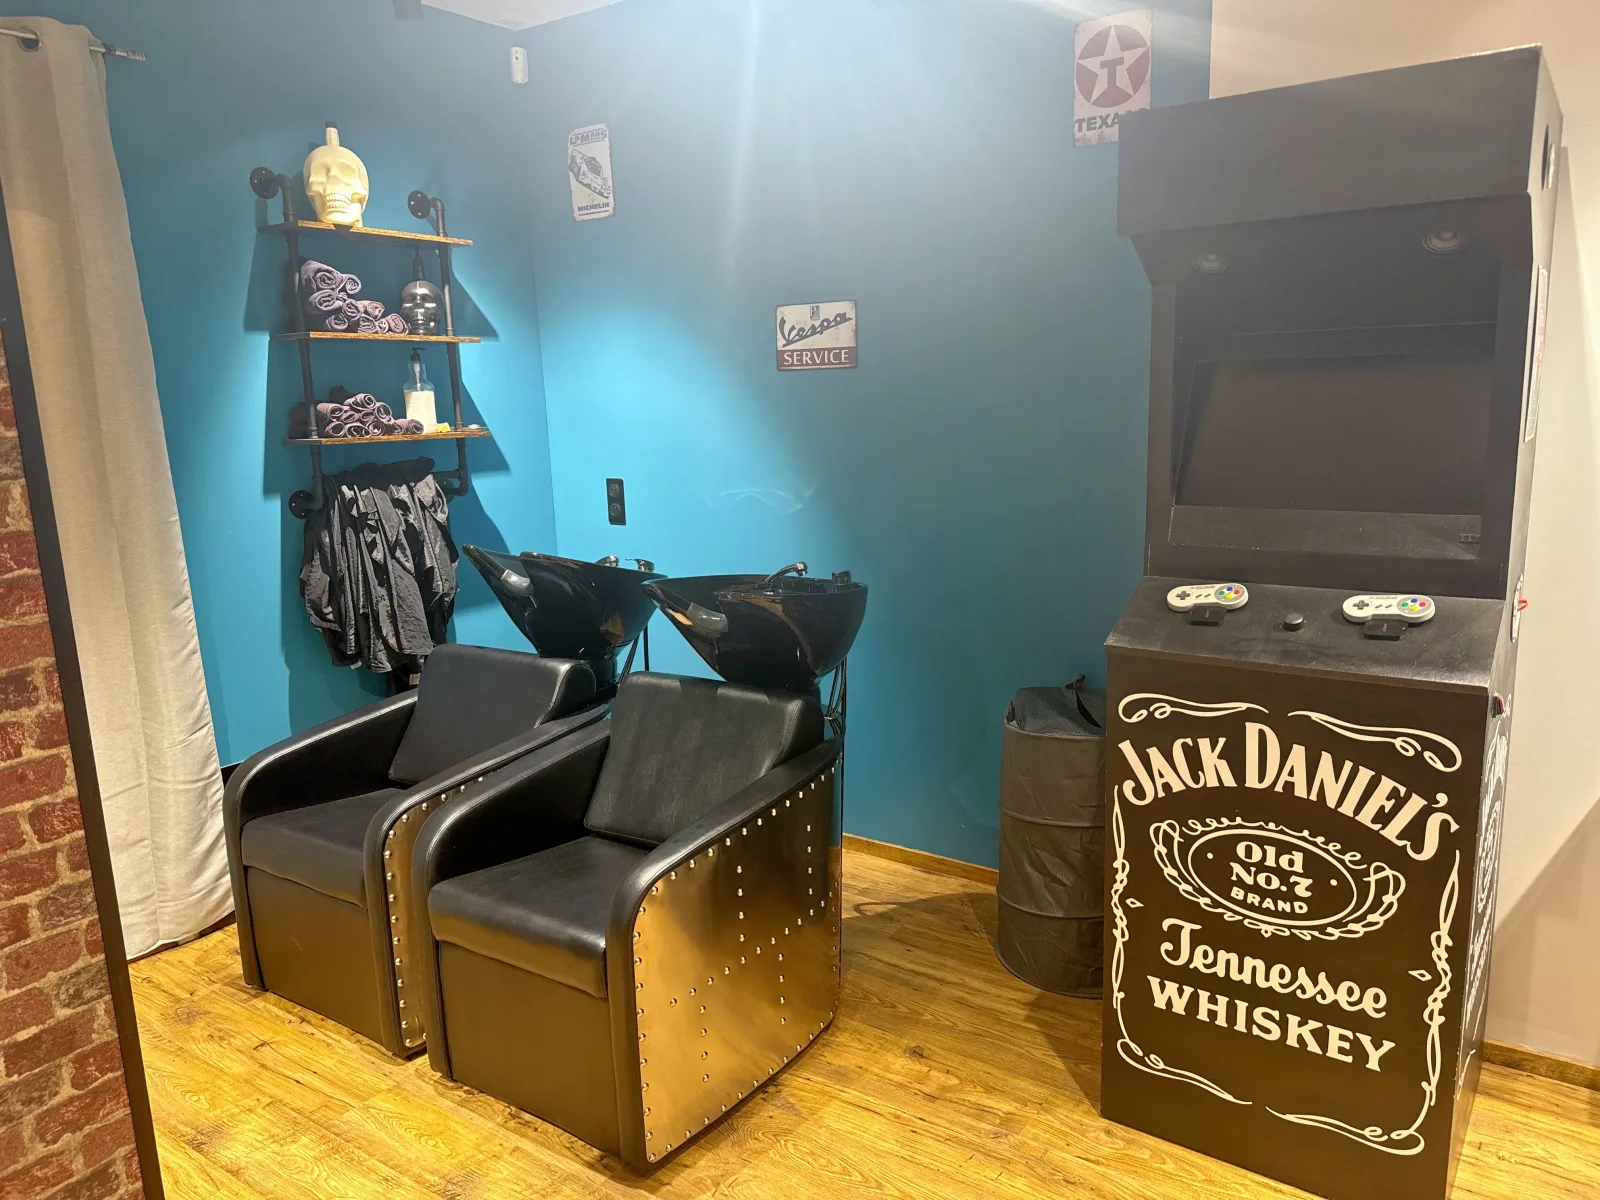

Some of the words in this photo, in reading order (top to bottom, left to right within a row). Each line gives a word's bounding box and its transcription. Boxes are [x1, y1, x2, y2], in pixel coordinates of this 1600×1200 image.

[577, 202, 610, 212] MICHELIN
[778, 312, 853, 348] Vespa
[783, 349, 849, 365] SERVICE
[1117, 737, 1237, 806] JACK
[1244, 721, 1461, 861] DANIEL'S
[1236, 840, 1304, 873] Old
[1230, 886, 1309, 914] BRAND
[1160, 917, 1388, 1019] Tennessee
[1147, 975, 1396, 1072] WHISKEY
